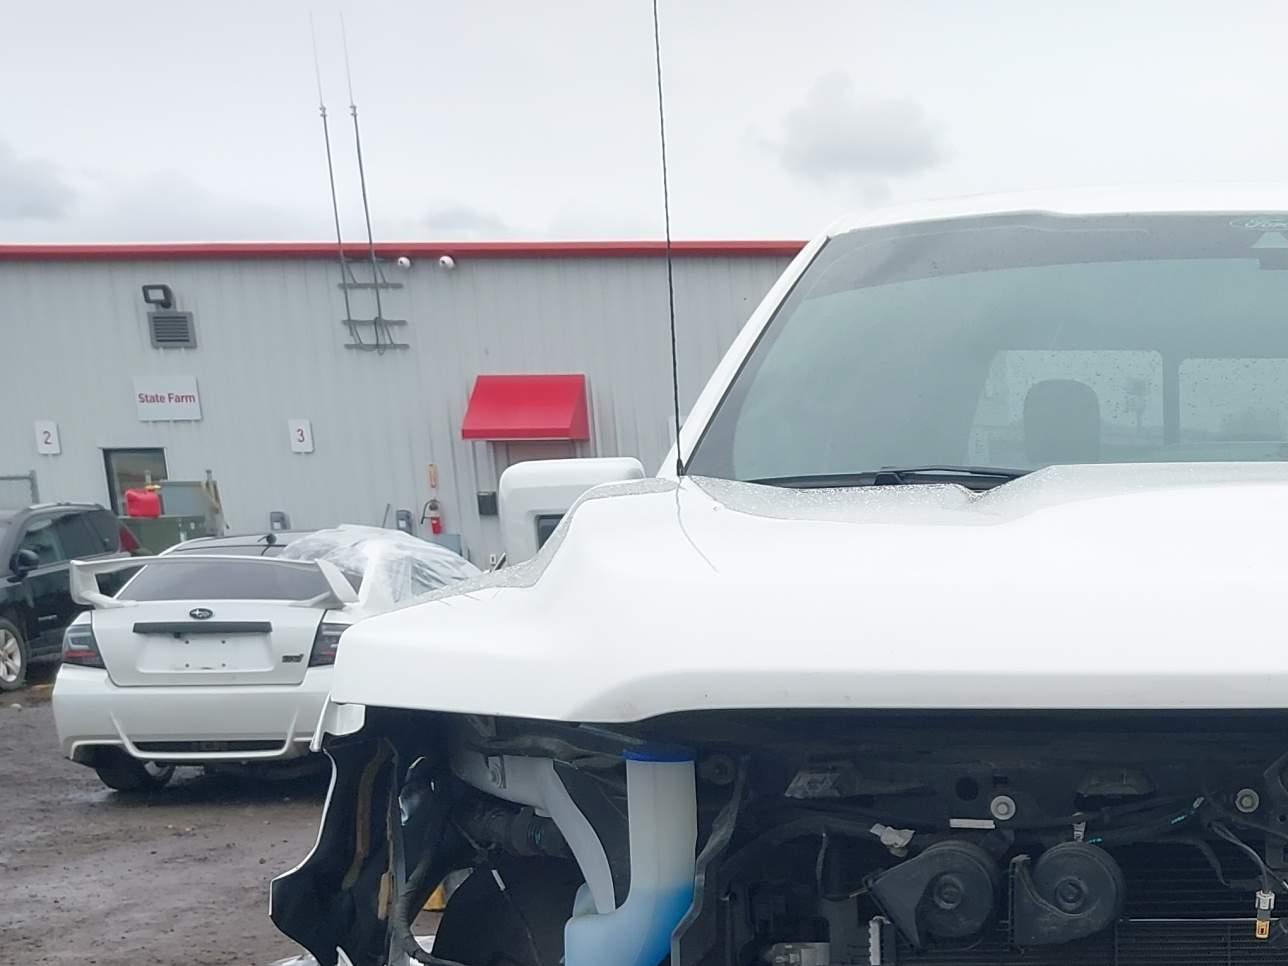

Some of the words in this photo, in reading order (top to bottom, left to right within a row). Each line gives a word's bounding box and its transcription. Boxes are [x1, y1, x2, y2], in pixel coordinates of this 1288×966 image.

[138, 393, 166, 403] State
[167, 393, 196, 403] Farm
[42, 430, 52, 445] 2
[297, 428, 305, 443] 3
